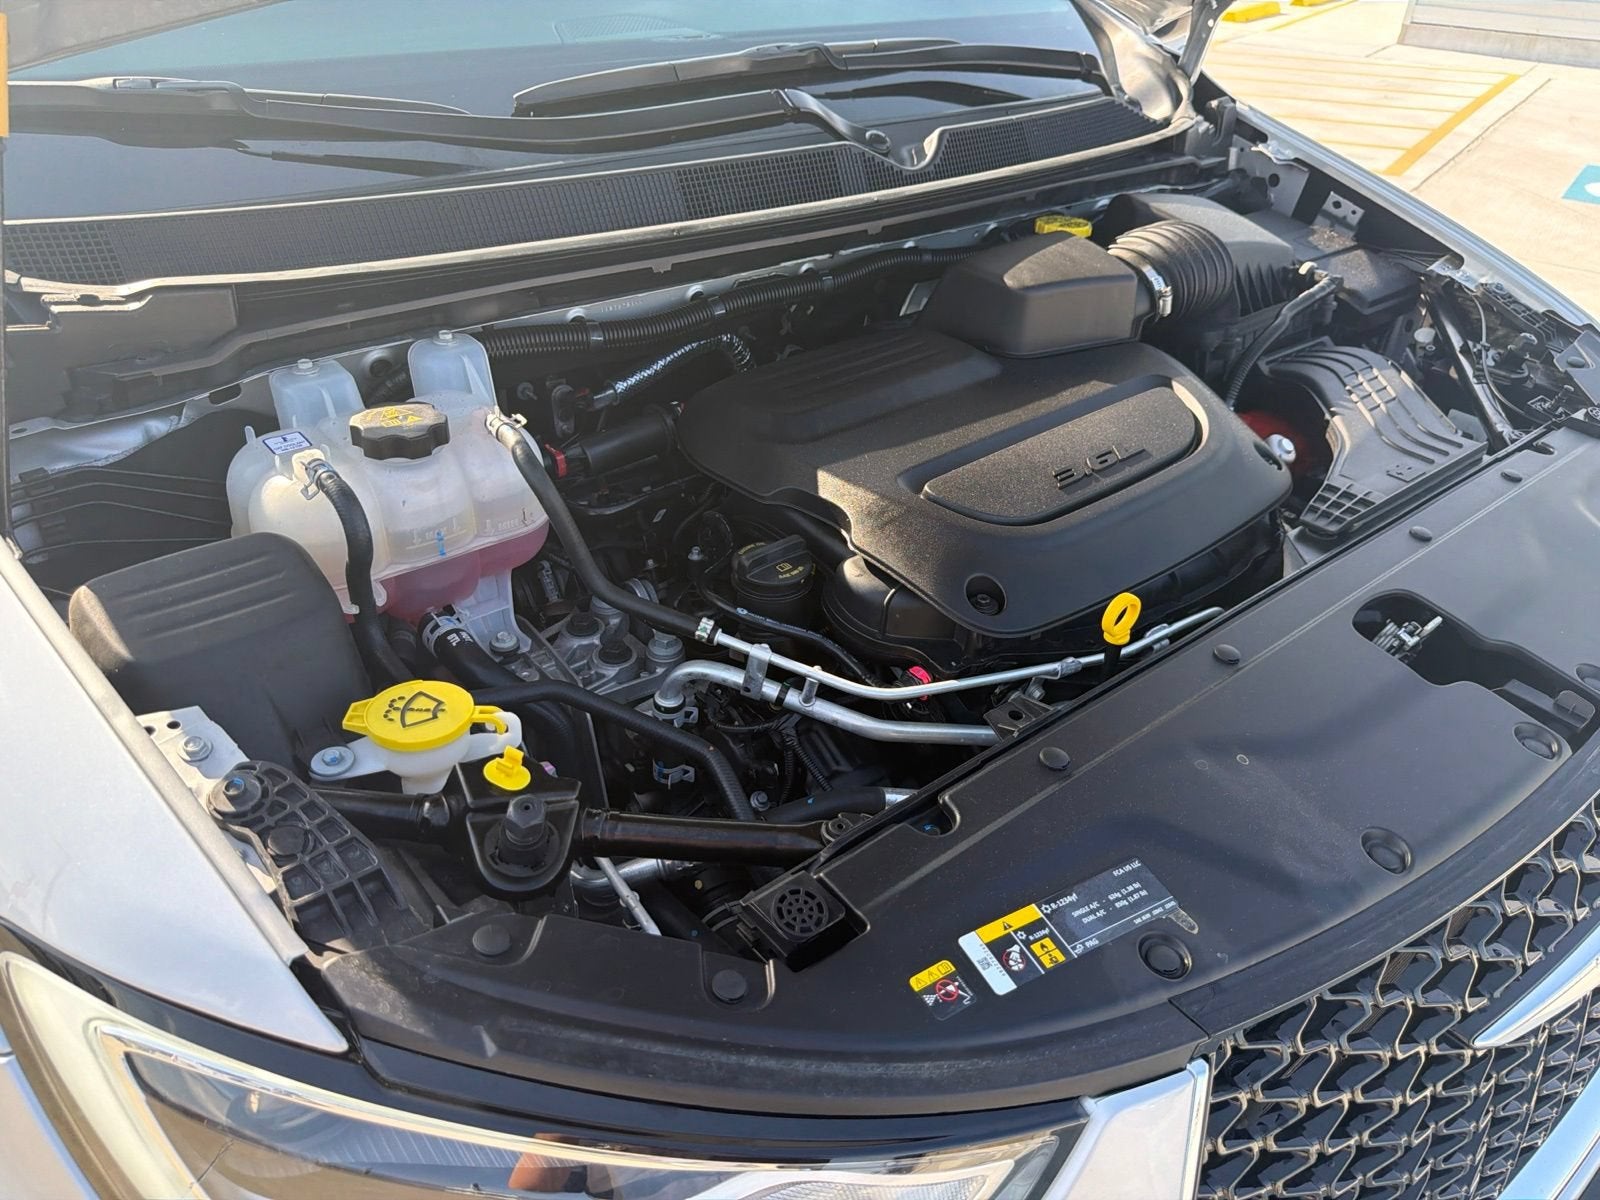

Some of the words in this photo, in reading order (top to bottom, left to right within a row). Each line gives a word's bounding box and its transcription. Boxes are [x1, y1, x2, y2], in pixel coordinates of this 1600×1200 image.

[1052, 445, 1147, 490] 3.6L
[1131, 860, 1142, 868] LLC
[1050, 892, 1078, 910] R-1234yf
[1071, 906, 1091, 917] SINGLE
[1089, 900, 1100, 910] A/C
[1082, 914, 1097, 924] DUAL
[1096, 908, 1107, 917] A/C
[1084, 938, 1100, 948] PAG
